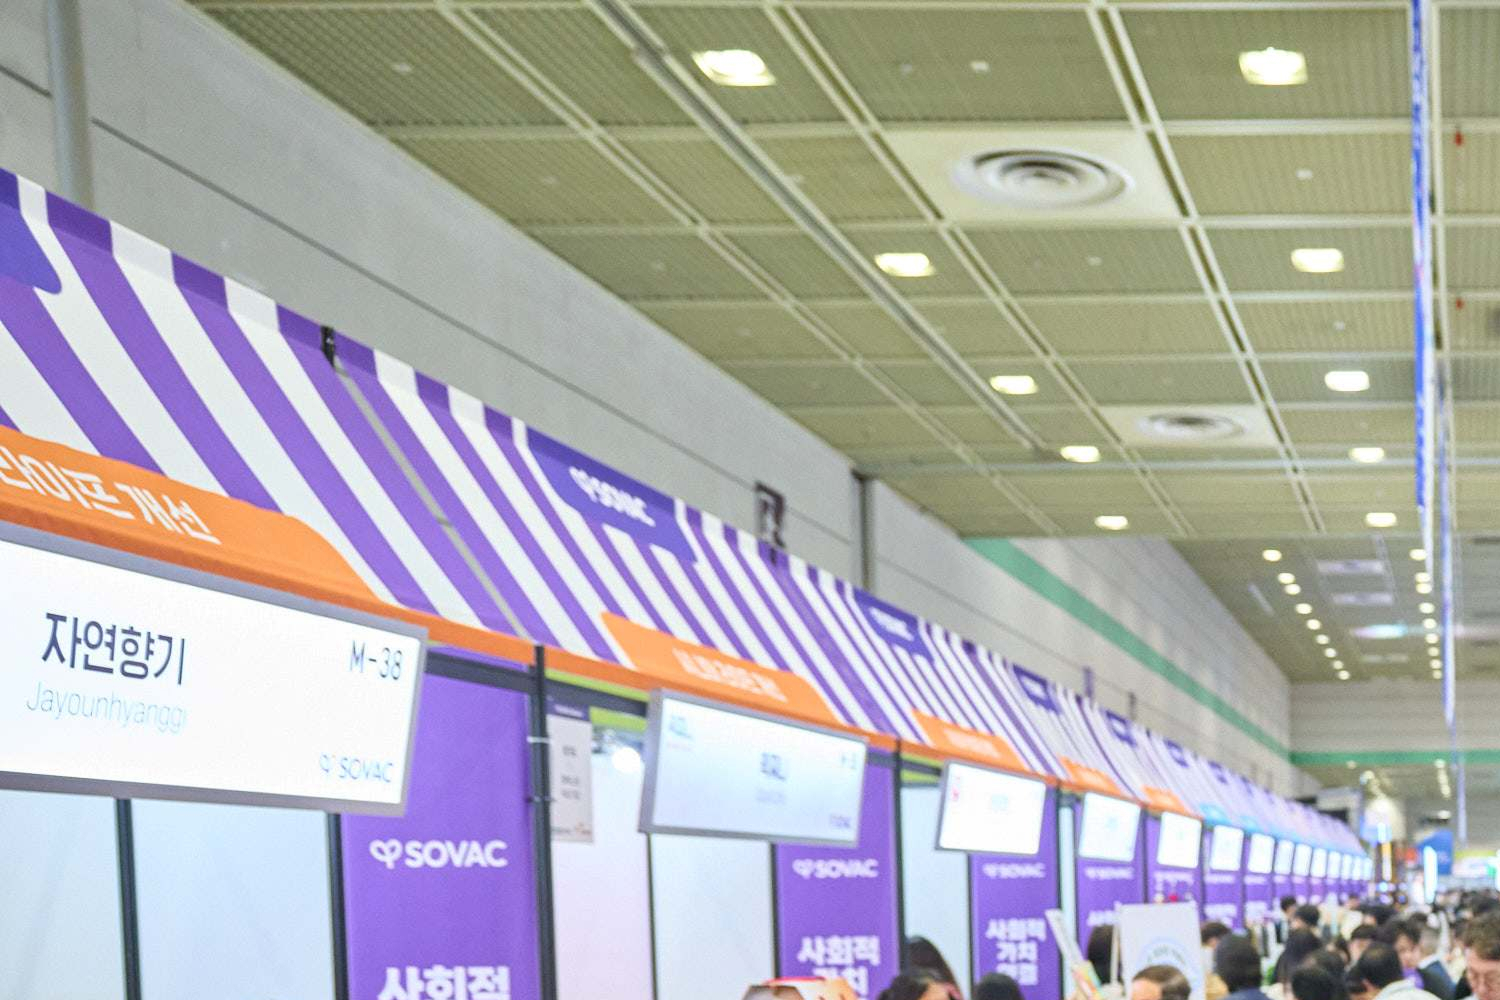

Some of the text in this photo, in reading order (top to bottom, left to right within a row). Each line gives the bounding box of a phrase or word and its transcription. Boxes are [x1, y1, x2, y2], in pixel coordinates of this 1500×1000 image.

[113, 482, 221, 545] 개선
[41, 612, 187, 686] 자연향기
[348, 640, 403, 681] M-38
[26, 682, 189, 734] Jayounhyanggi
[338, 756, 395, 784] SOVAC
[404, 839, 509, 868] SOVAC
[814, 858, 879, 879] SOVAC
[797, 936, 881, 967] 사회적
